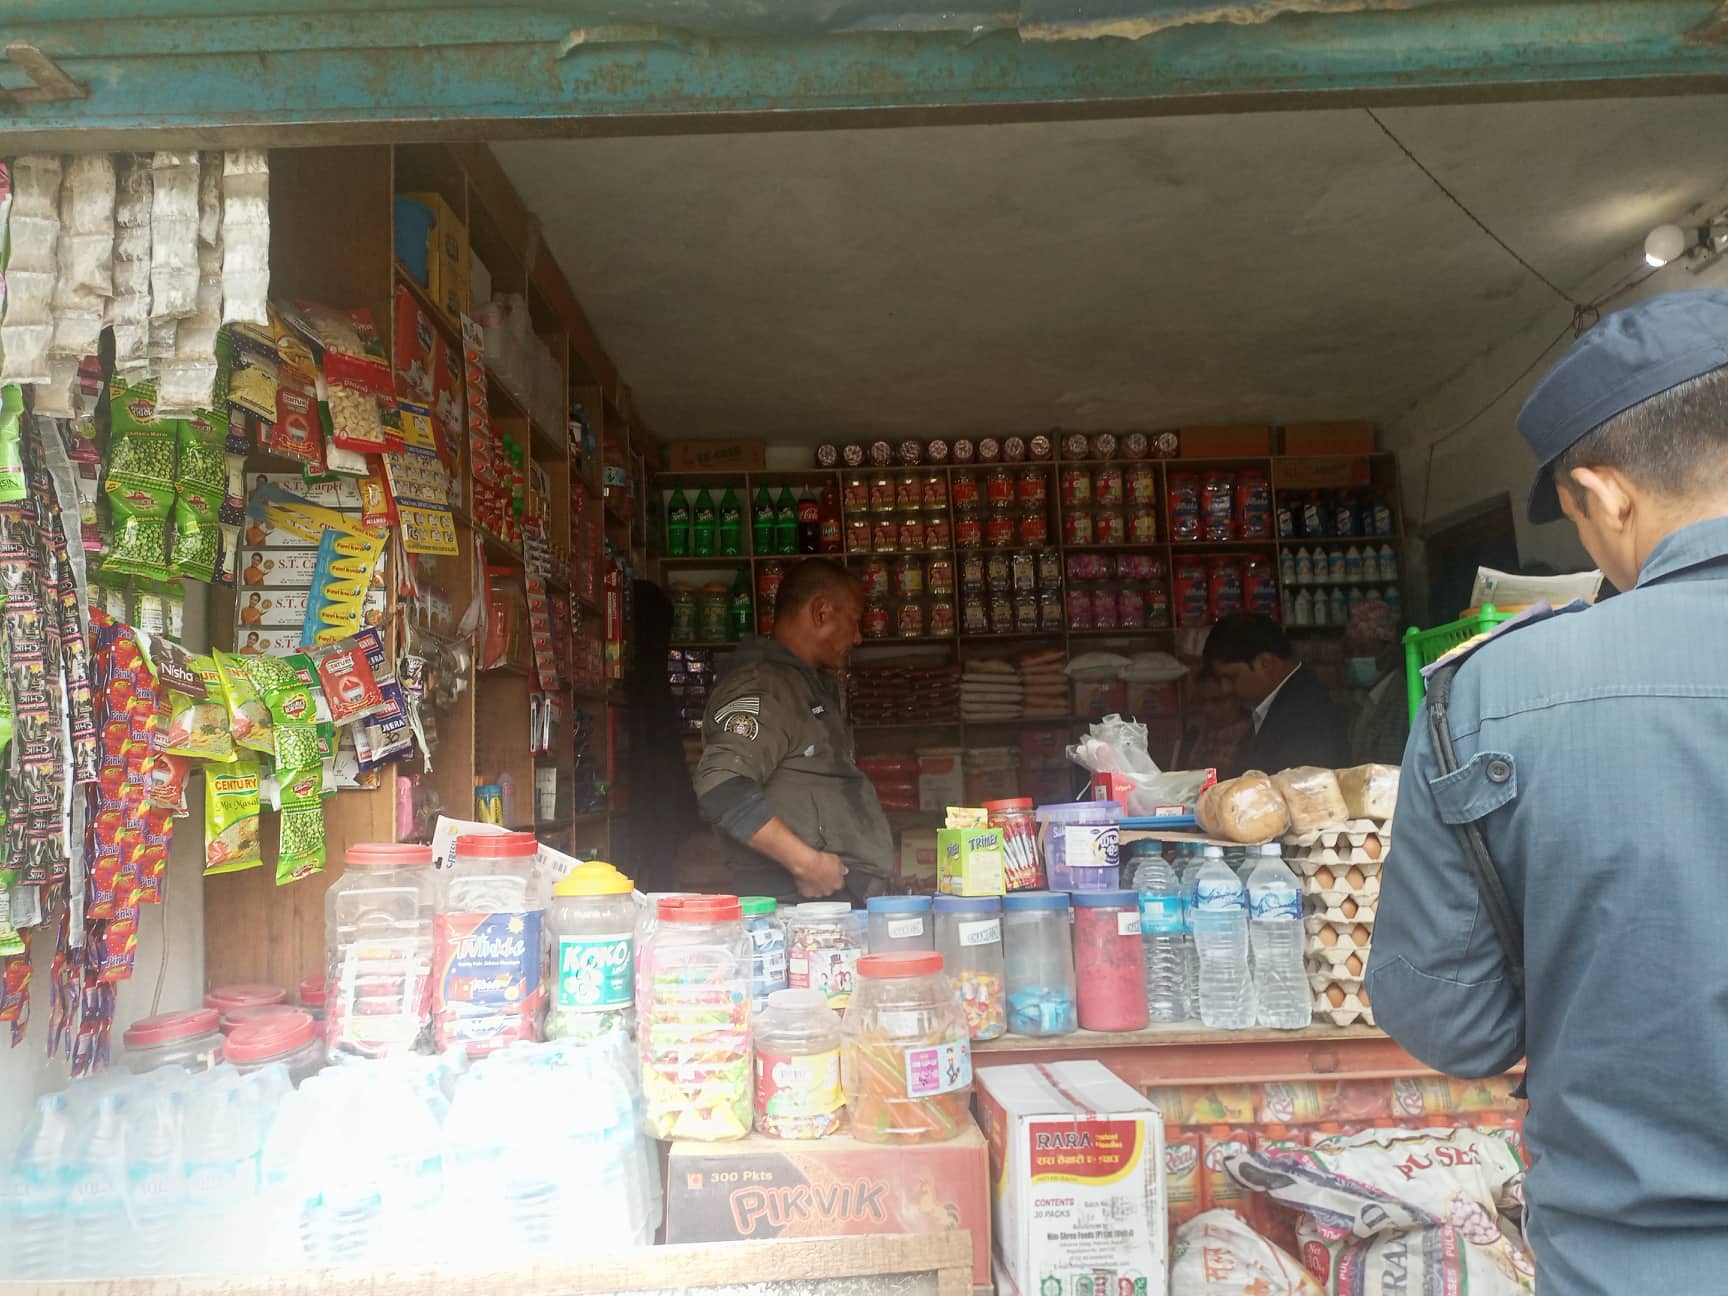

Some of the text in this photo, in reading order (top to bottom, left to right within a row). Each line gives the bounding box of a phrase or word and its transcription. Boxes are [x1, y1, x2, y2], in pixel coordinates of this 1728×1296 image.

[161, 662, 194, 681] Nisha
[381, 719, 405, 733] JEERA
[215, 778, 257, 791] CENTURY
[1034, 1131, 1093, 1150] RARA
[711, 1170, 773, 1184] 300 Pkts
[730, 1177, 889, 1235] PIKVIK
[1034, 1198, 1075, 1208] CONTENTS
[1044, 1209, 1071, 1219] PACKS
